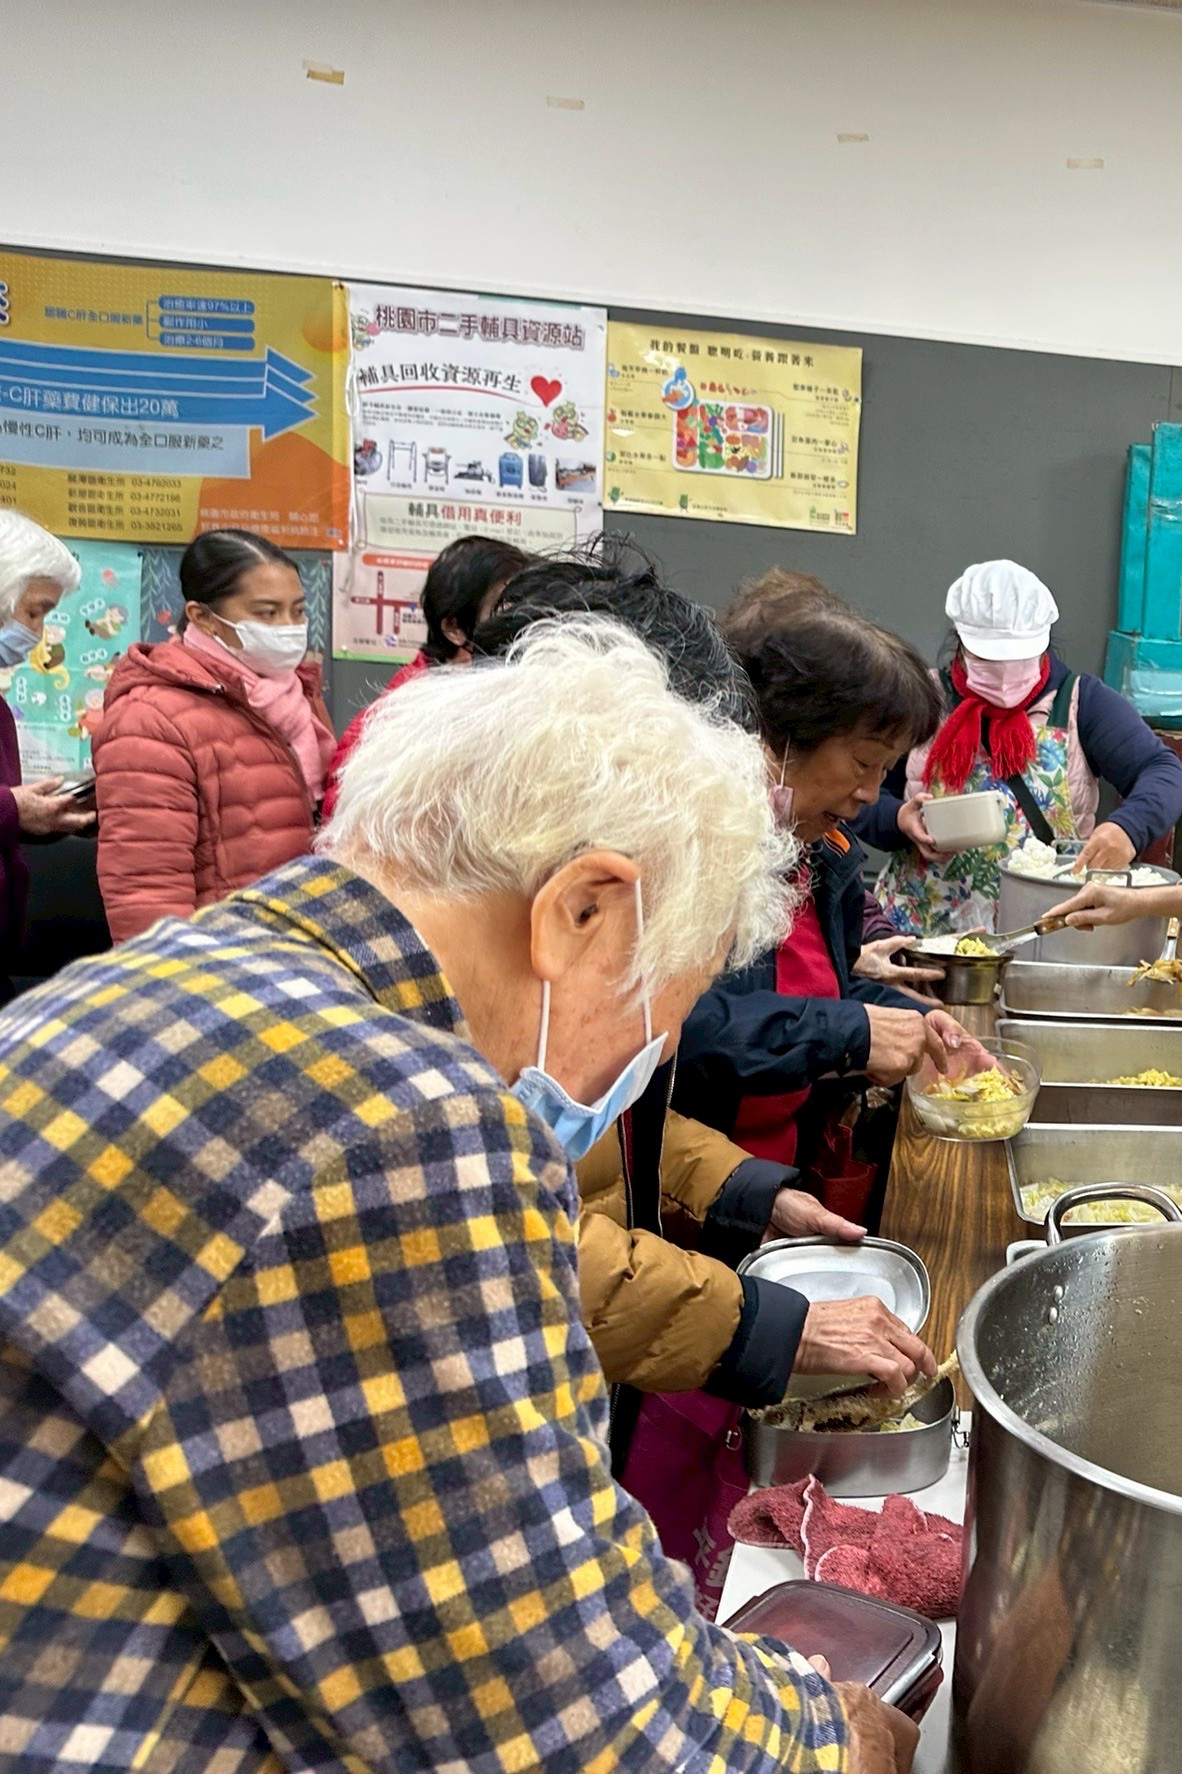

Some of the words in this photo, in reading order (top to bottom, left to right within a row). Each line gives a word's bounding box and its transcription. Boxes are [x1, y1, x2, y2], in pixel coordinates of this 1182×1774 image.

[375, 305, 585, 350] 桃園市二手輔具資源站
[359, 362, 522, 394] 輔具回收資源再生
[0, 385, 179, 419] -C肝藥費健保出20萬
[408, 502, 523, 527] 輔具借用真便利
